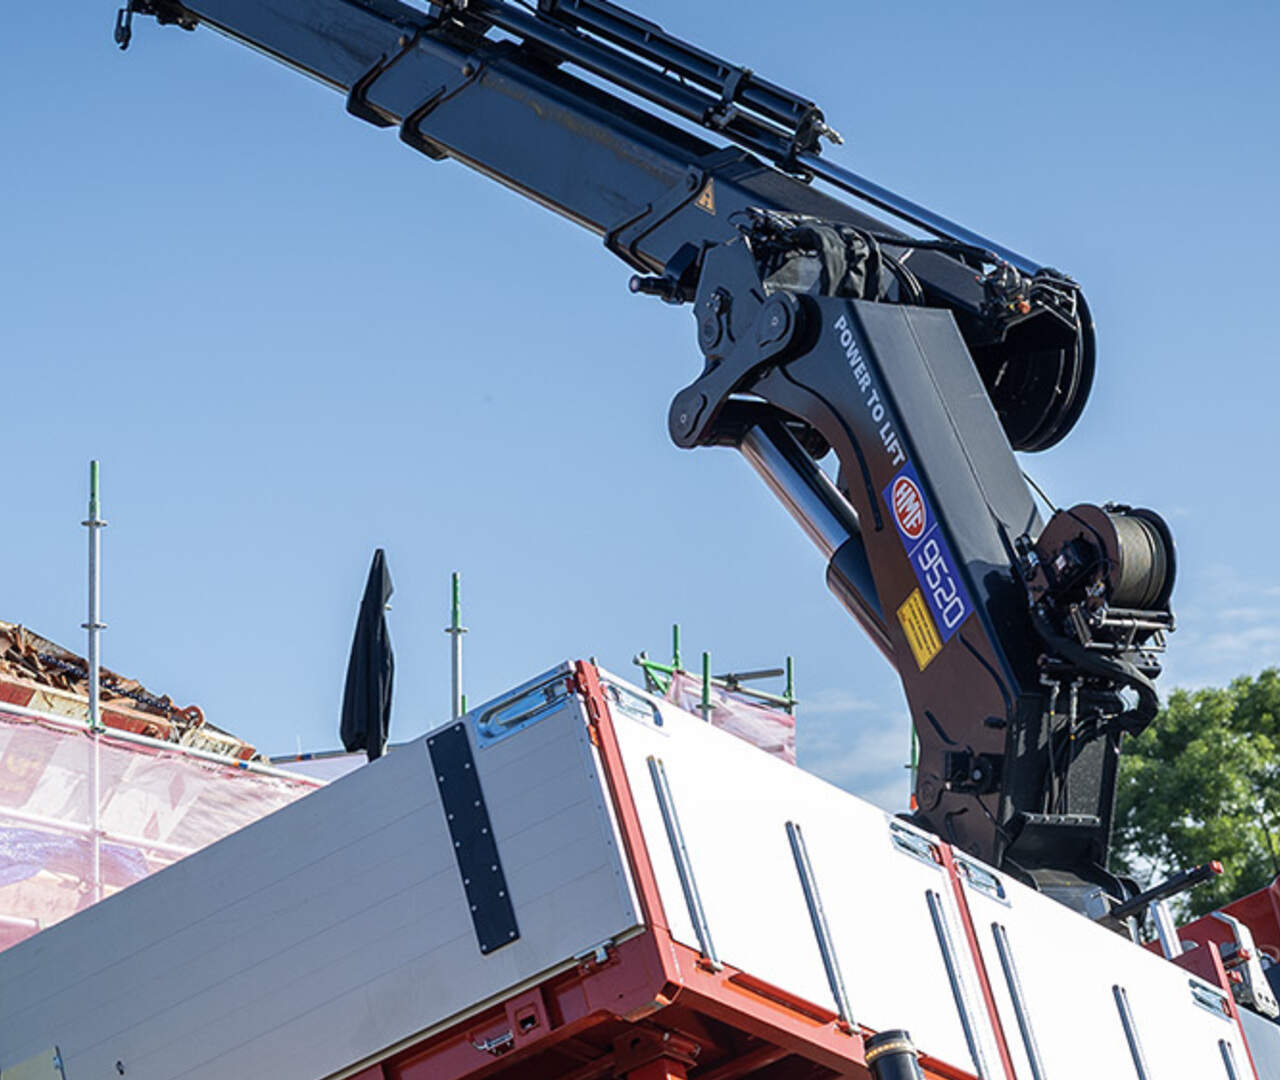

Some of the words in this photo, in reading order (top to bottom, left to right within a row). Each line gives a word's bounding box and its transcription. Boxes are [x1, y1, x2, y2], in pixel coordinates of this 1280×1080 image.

[834, 315, 871, 392] POWER
[866, 389, 885, 422] TO
[879, 422, 906, 466] LIFT
[894, 482, 923, 531] HMF
[918, 539, 965, 629] 9520
